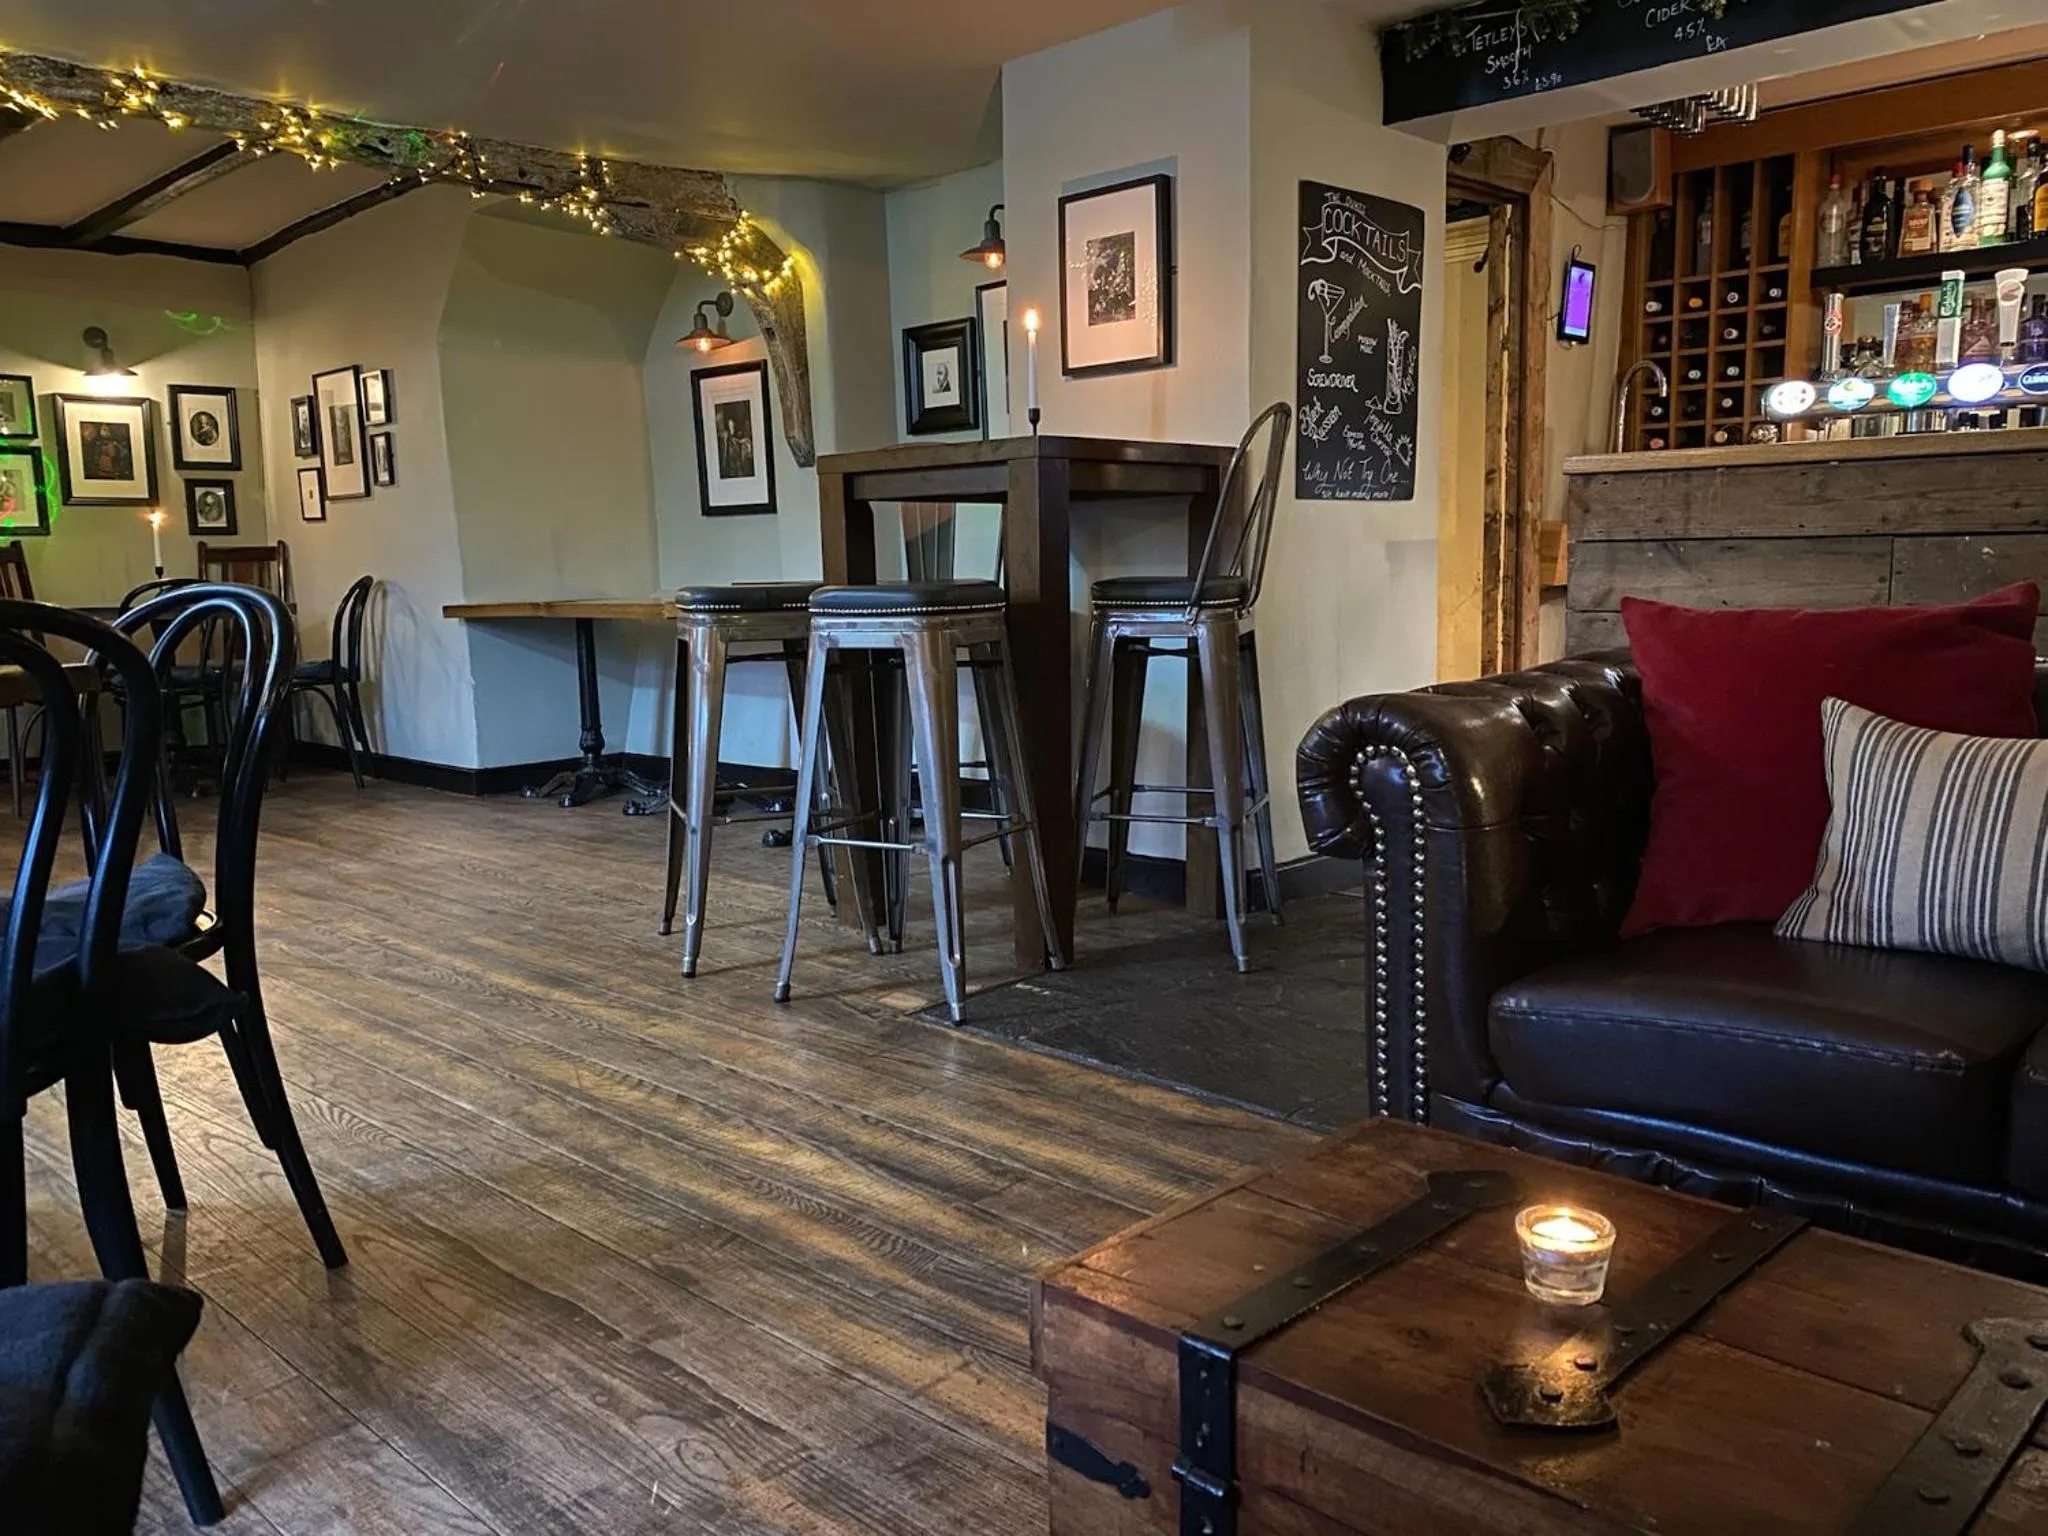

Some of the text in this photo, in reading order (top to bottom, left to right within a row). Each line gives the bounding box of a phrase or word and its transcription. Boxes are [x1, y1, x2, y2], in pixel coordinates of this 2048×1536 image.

[1645, 0, 1695, 28] CIDER
[1323, 207, 1406, 262] COCKTAILS
[1302, 461, 1335, 494] Why
[1333, 457, 1355, 481] Not
[1359, 456, 1377, 494] Try
